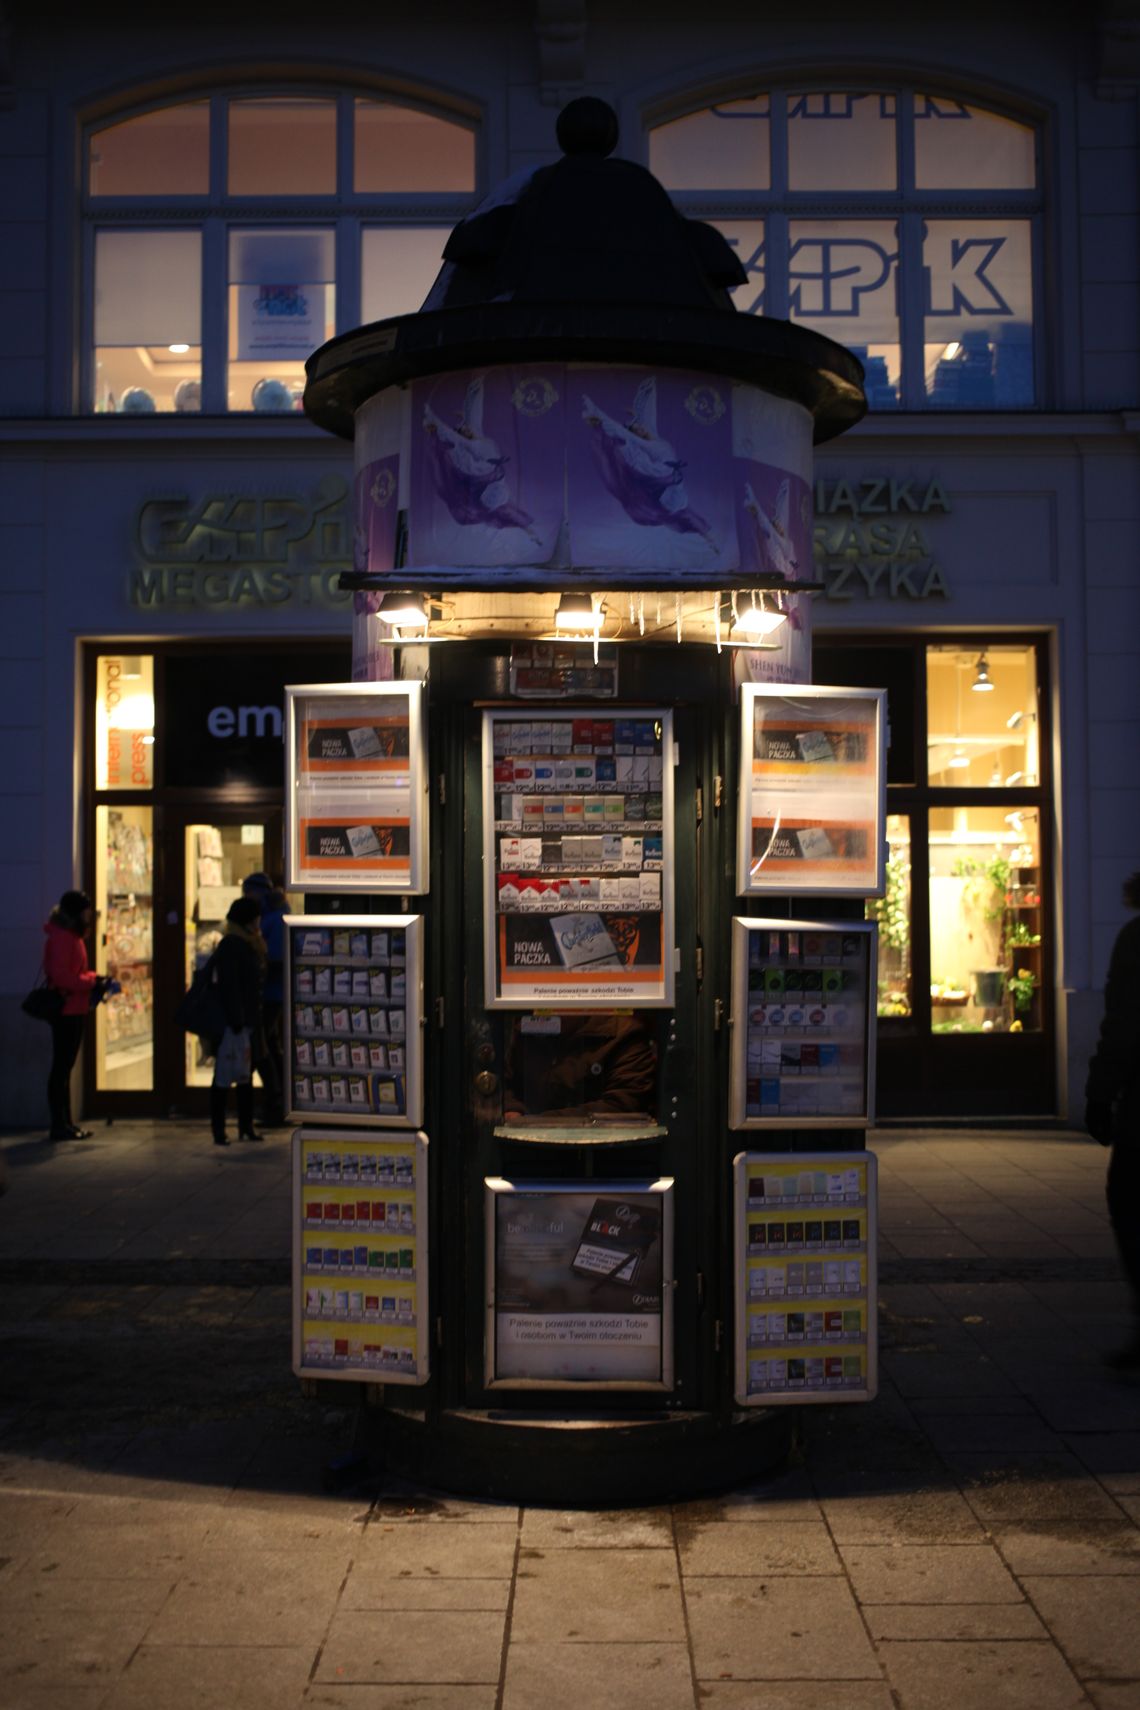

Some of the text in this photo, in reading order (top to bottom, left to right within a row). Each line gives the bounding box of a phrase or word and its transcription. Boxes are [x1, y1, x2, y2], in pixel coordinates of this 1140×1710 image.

[514, 941, 545, 953] NOWA
[514, 953, 551, 965] PACZKA
[590, 1219, 622, 1237] BLACK
[509, 1318, 543, 1328] Palenie
[625, 1319, 649, 1329] Tobie
